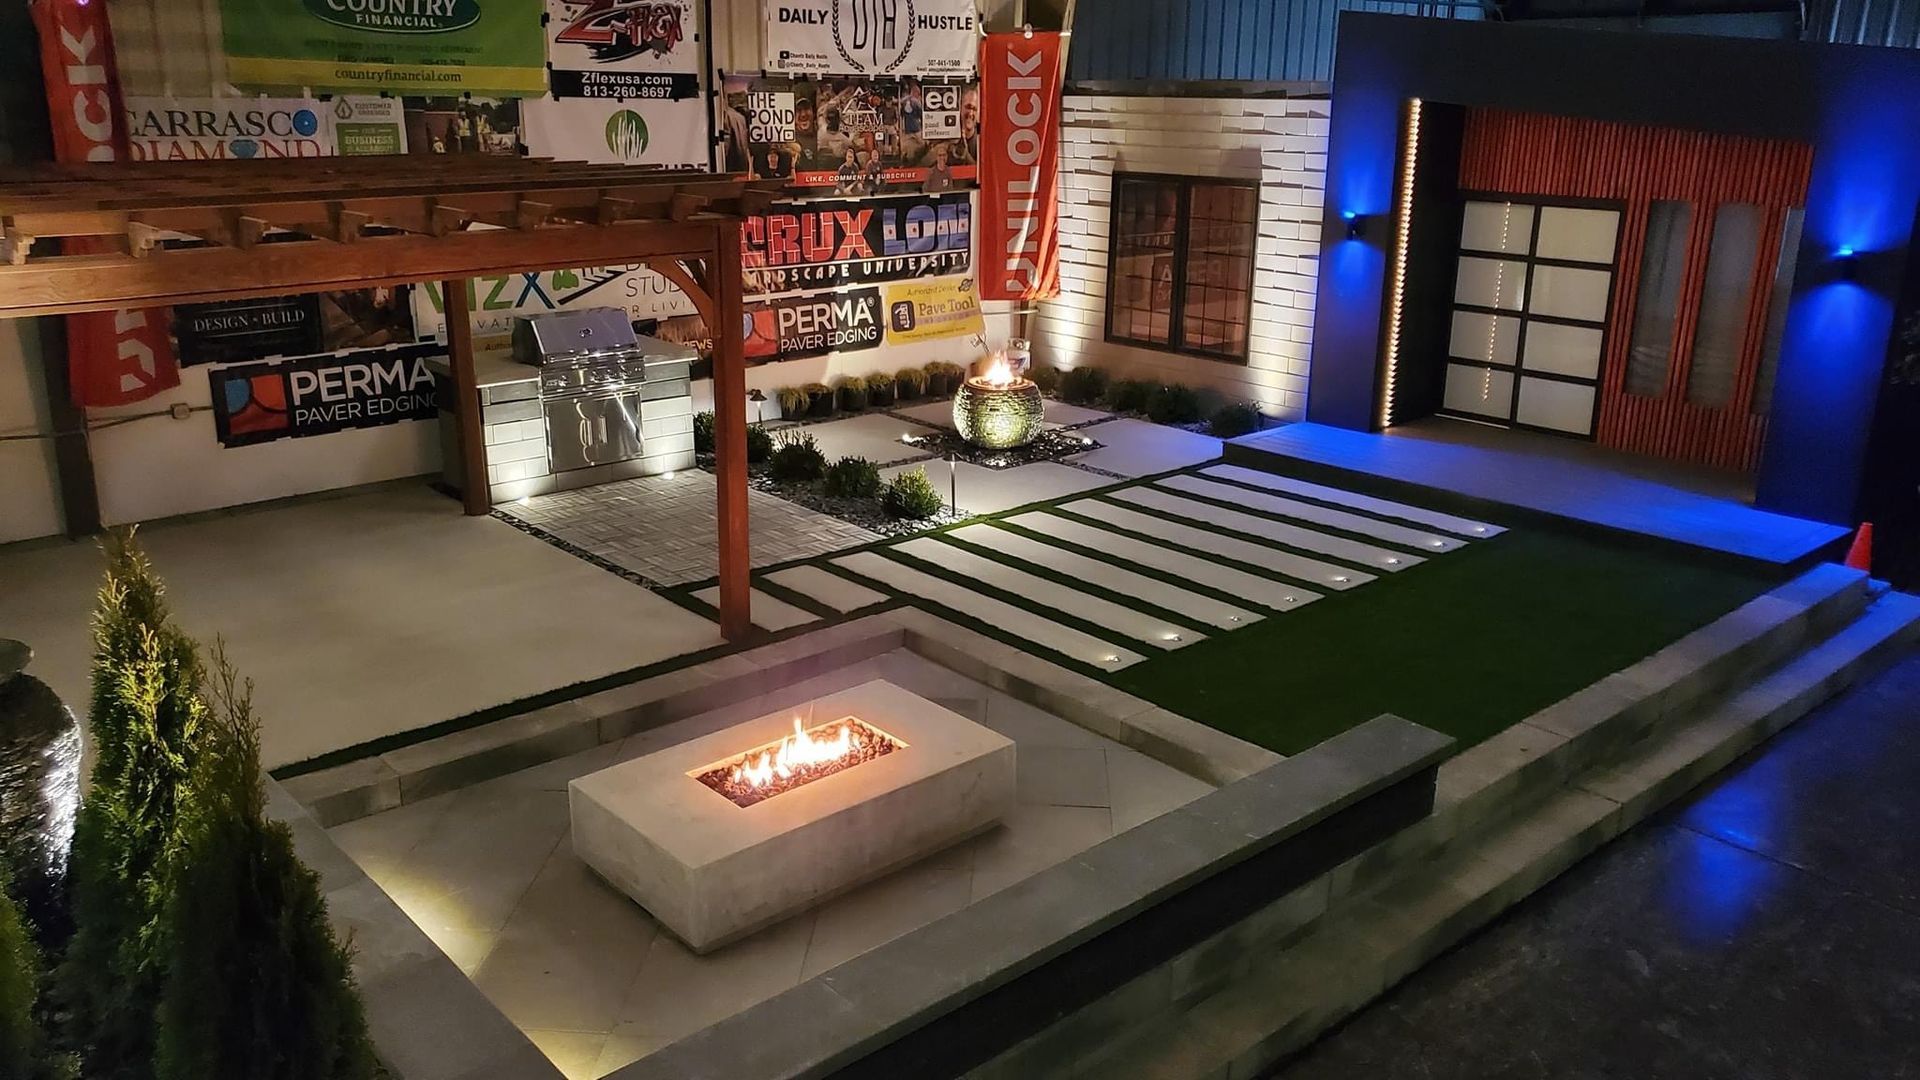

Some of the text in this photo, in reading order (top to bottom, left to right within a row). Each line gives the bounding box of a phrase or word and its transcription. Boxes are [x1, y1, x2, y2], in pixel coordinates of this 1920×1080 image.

[355, 13, 437, 28] FINANCIAL
[778, 7, 829, 25] DAILY
[918, 14, 973, 31] HUSTLE
[335, 68, 462, 83] countryfinancial.com
[581, 72, 673, 85] Zflexusa.com
[583, 86, 673, 98] 813-260-8697
[747, 92, 776, 109] THE
[925, 86, 958, 110] ed
[750, 109, 794, 125] POND
[848, 112, 884, 126] TEAM
[344, 136, 393, 145] BUSINESS
[751, 126, 784, 142] GUY
[805, 175, 826, 184] LIKE,
[828, 173, 867, 183] COMMENT
[876, 171, 917, 181] SUBSCRIBE
[1005, 49, 1043, 293] UNILOCK
[740, 208, 875, 268] CRUX
[863, 251, 970, 277] UNIVERSITY
[918, 302, 946, 317] Pave
[947, 295, 976, 312] Tool
[193, 309, 306, 333] DESIGN BUILD
[781, 326, 878, 353] PAVER EDGING
[289, 356, 437, 407] PERMA
[295, 401, 362, 427] PAVER
